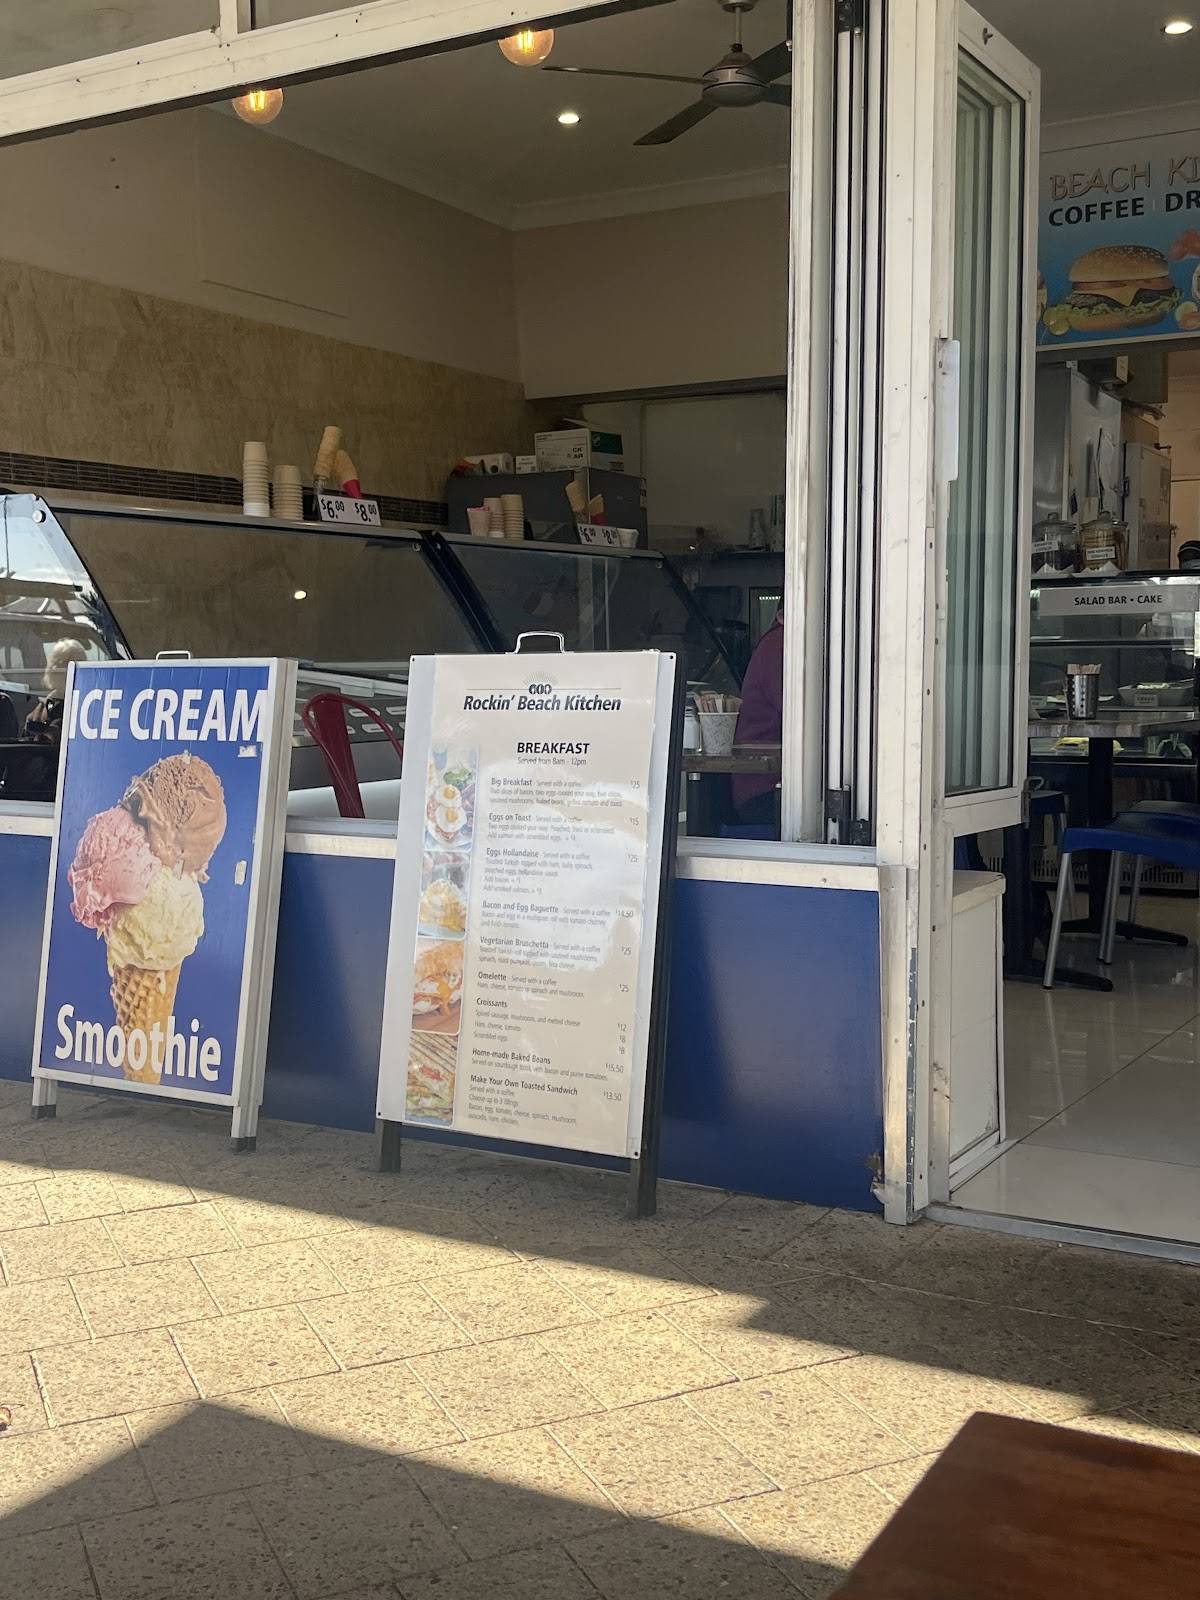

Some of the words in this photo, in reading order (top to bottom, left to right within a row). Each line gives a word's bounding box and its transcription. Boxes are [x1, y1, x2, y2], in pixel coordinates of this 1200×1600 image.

[1050, 160, 1150, 201] BEACH
[1049, 197, 1145, 226] COFFEE
[1165, 190, 1200, 212] DR
[321, 498, 344, 519] $6.00
[354, 502, 377, 522] $8.00
[1074, 596, 1105, 606] SALAD
[1108, 595, 1127, 605] BAR
[1137, 595, 1162, 604] CAKE
[463, 694, 515, 711] Rockin'
[517, 694, 561, 711] Beach
[564, 694, 621, 711] Kitchen
[69, 689, 122, 740] ICE
[130, 688, 268, 742] CREAM
[517, 742, 590, 754] BREAKFAST
[552, 757, 565, 765] 8am
[491, 777, 502, 787] Big
[502, 777, 532, 786] Breakfast
[488, 812, 504, 823] Eggs
[514, 813, 532, 821] Toast
[486, 847, 501, 858] Eggs
[482, 900, 502, 908] Bacon
[502, 902, 515, 910] and
[516, 902, 529, 912] Egg
[530, 903, 559, 913] Baguette
[480, 936, 514, 945] Vegetarian
[515, 938, 549, 949] Bruschetta
[478, 971, 507, 981] Omelette
[476, 997, 508, 1008] Croissants
[55, 1003, 222, 1082] Smoothie
[472, 1048, 510, 1059] Home-made
[510, 1052, 530, 1062] Baked
[531, 1054, 551, 1065] Beans
[470, 1074, 488, 1084] Make
[488, 1076, 503, 1086] Your
[504, 1078, 519, 1088] Own
[521, 1080, 546, 1091] Toasted
[547, 1083, 578, 1096] Sandwich
